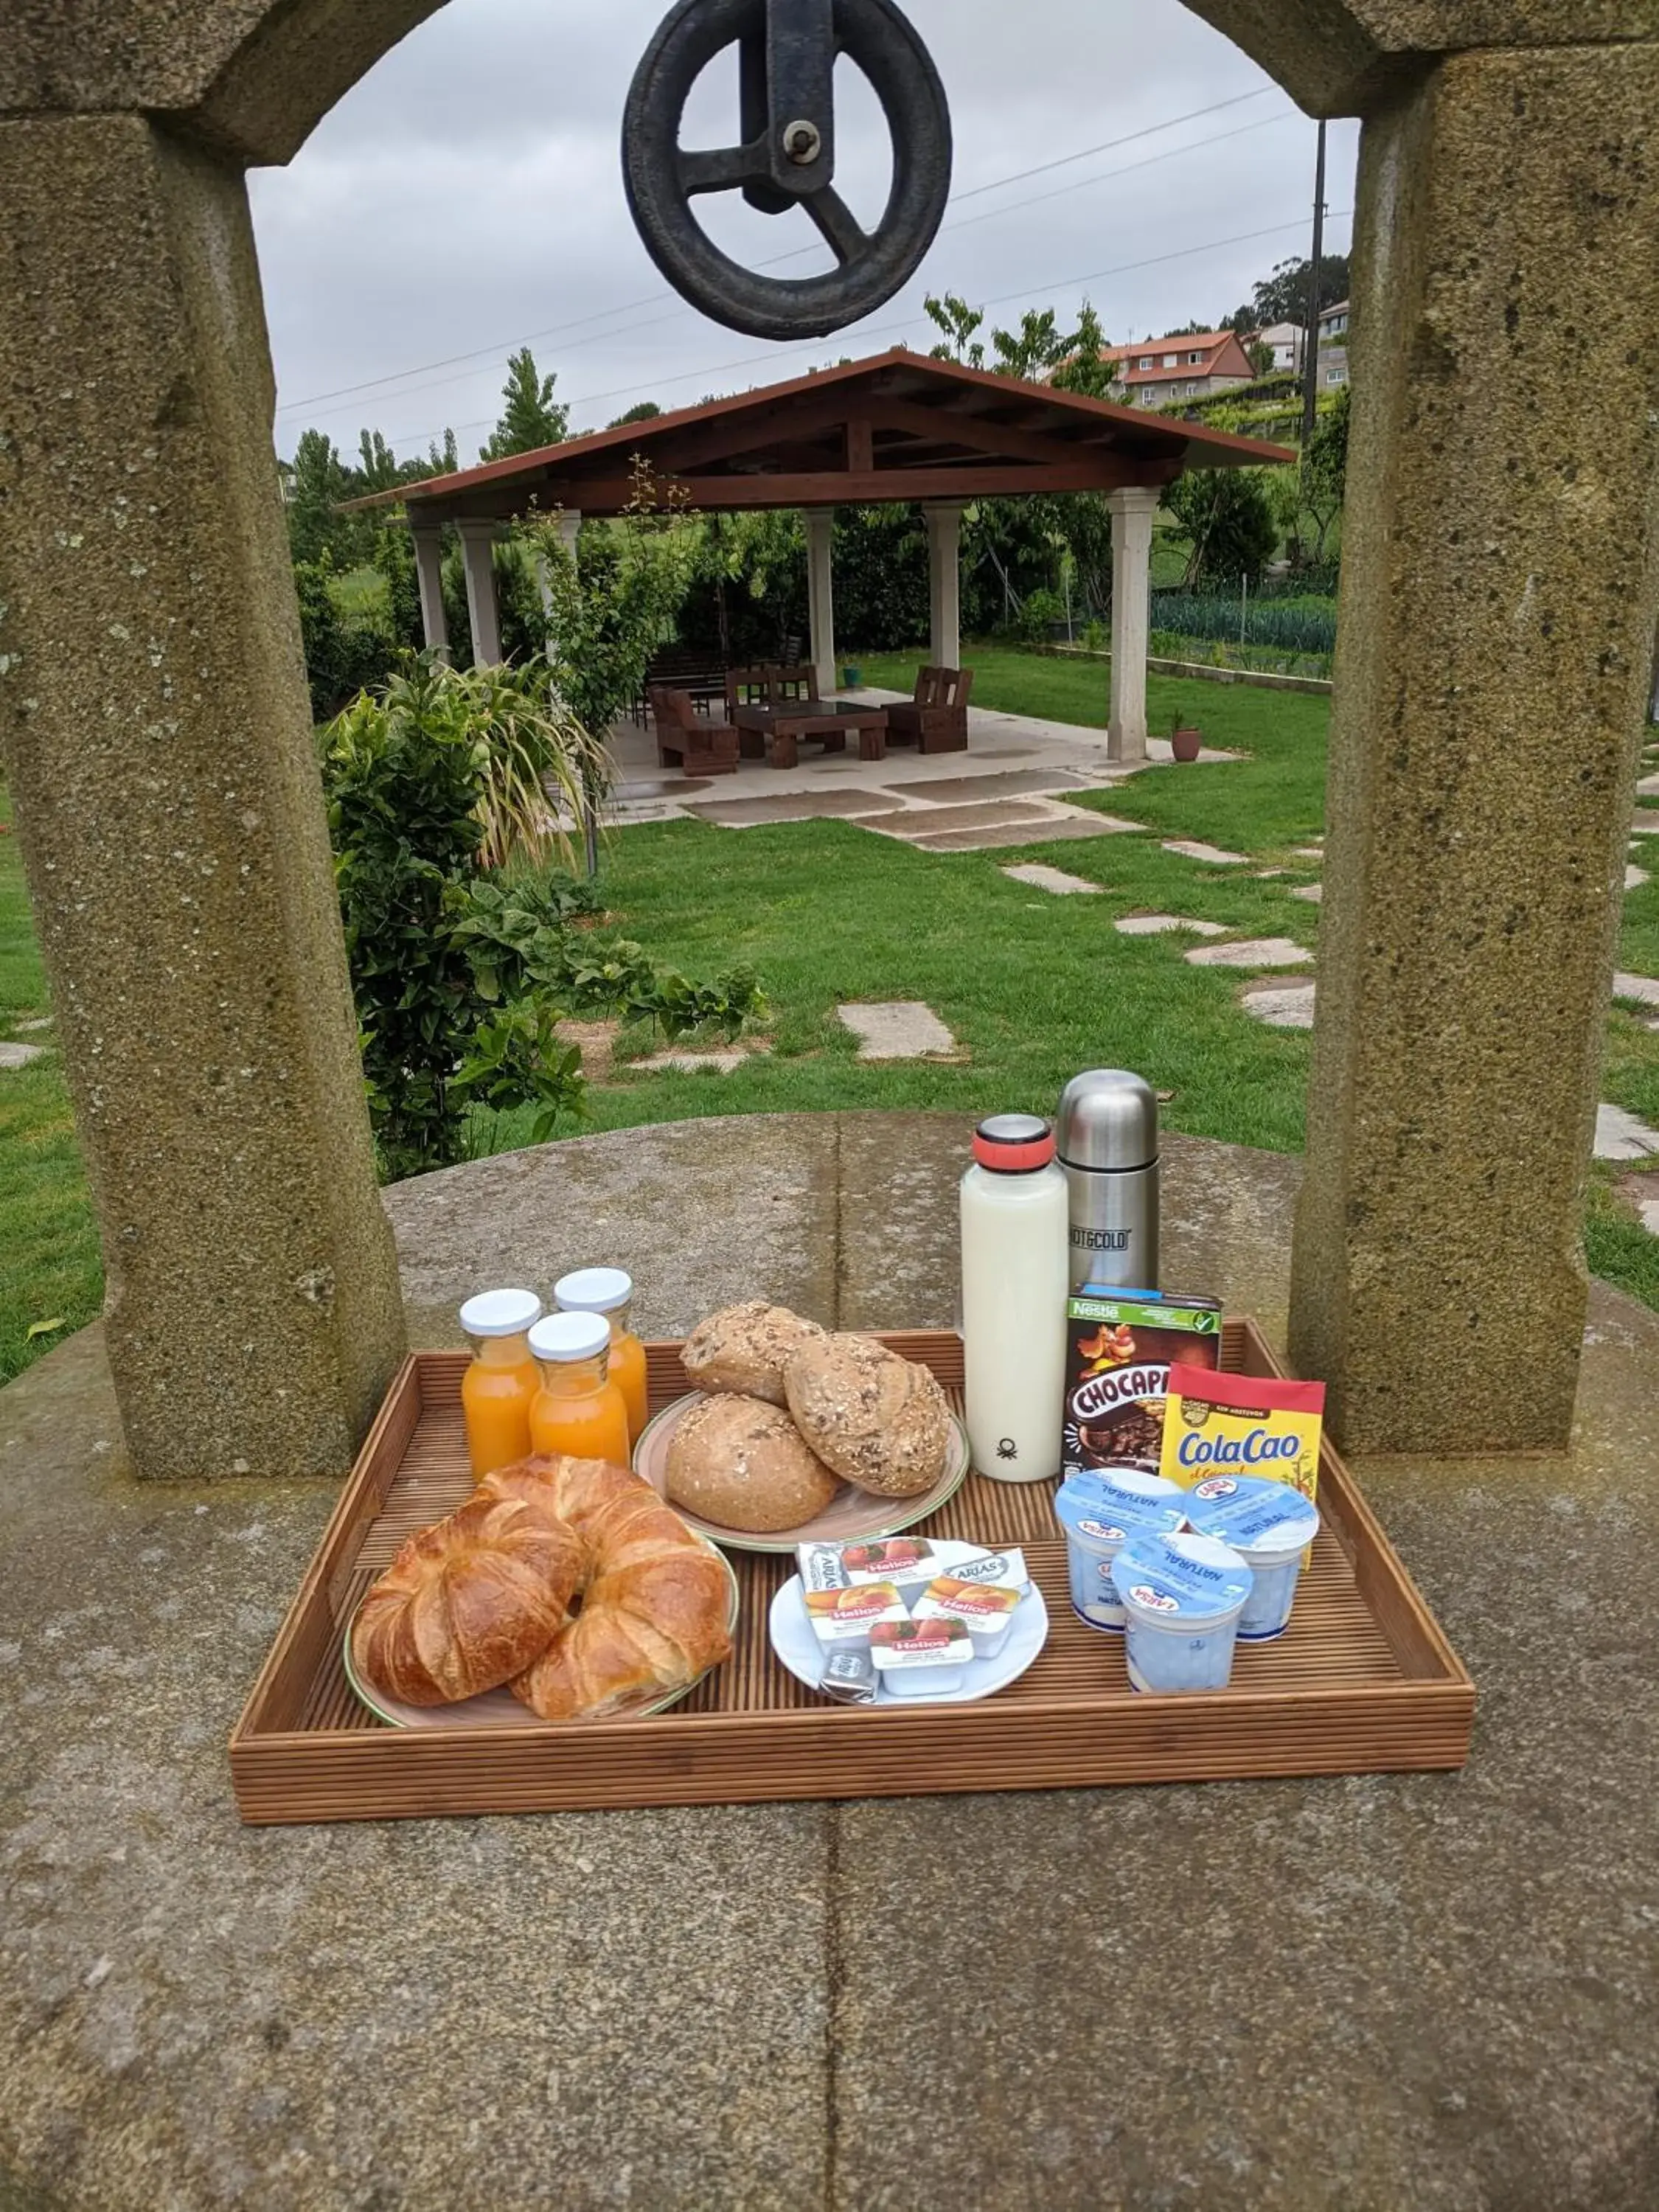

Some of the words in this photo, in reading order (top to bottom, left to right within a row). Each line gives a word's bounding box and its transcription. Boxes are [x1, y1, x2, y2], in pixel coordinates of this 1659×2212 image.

[1077, 1370, 1169, 1413] CHOCAPI
[1178, 1429, 1299, 1467] ColaCao
[1102, 1484, 1160, 1507] NATURAL
[869, 1559, 914, 1571] Helios
[958, 1562, 997, 1579] ARIAS
[1165, 1550, 1224, 1582] NATURAL
[944, 1599, 989, 1614] Helios
[1135, 1587, 1175, 1610] LARSA
[834, 1606, 881, 1618] Helios
[895, 1640, 945, 1649] Helios
